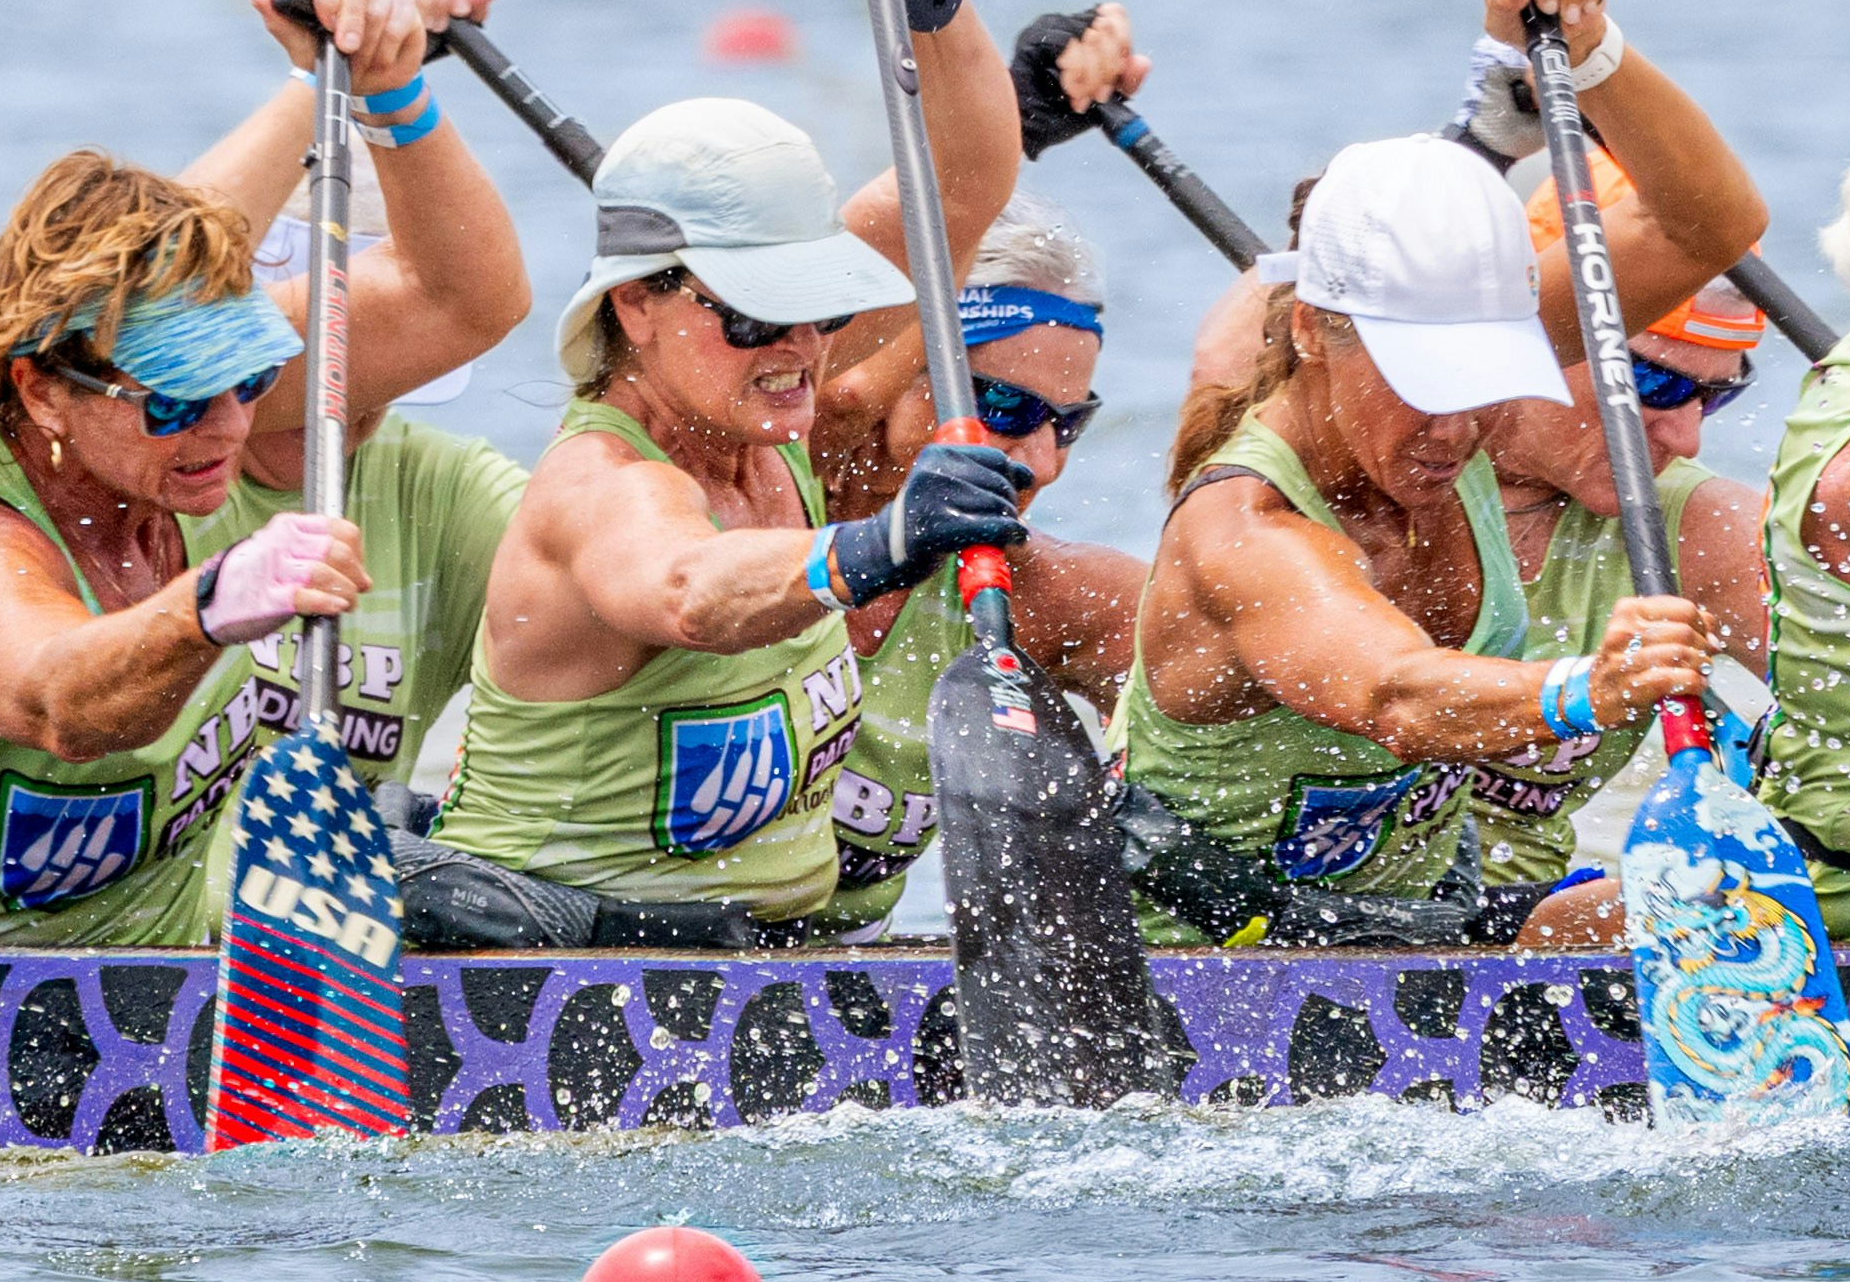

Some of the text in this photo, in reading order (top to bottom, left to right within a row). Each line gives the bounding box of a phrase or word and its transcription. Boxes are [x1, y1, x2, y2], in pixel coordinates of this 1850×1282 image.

[317, 260, 348, 423] HORNET
[1573, 223, 1640, 415] HORNET
[239, 865, 398, 969] USA
